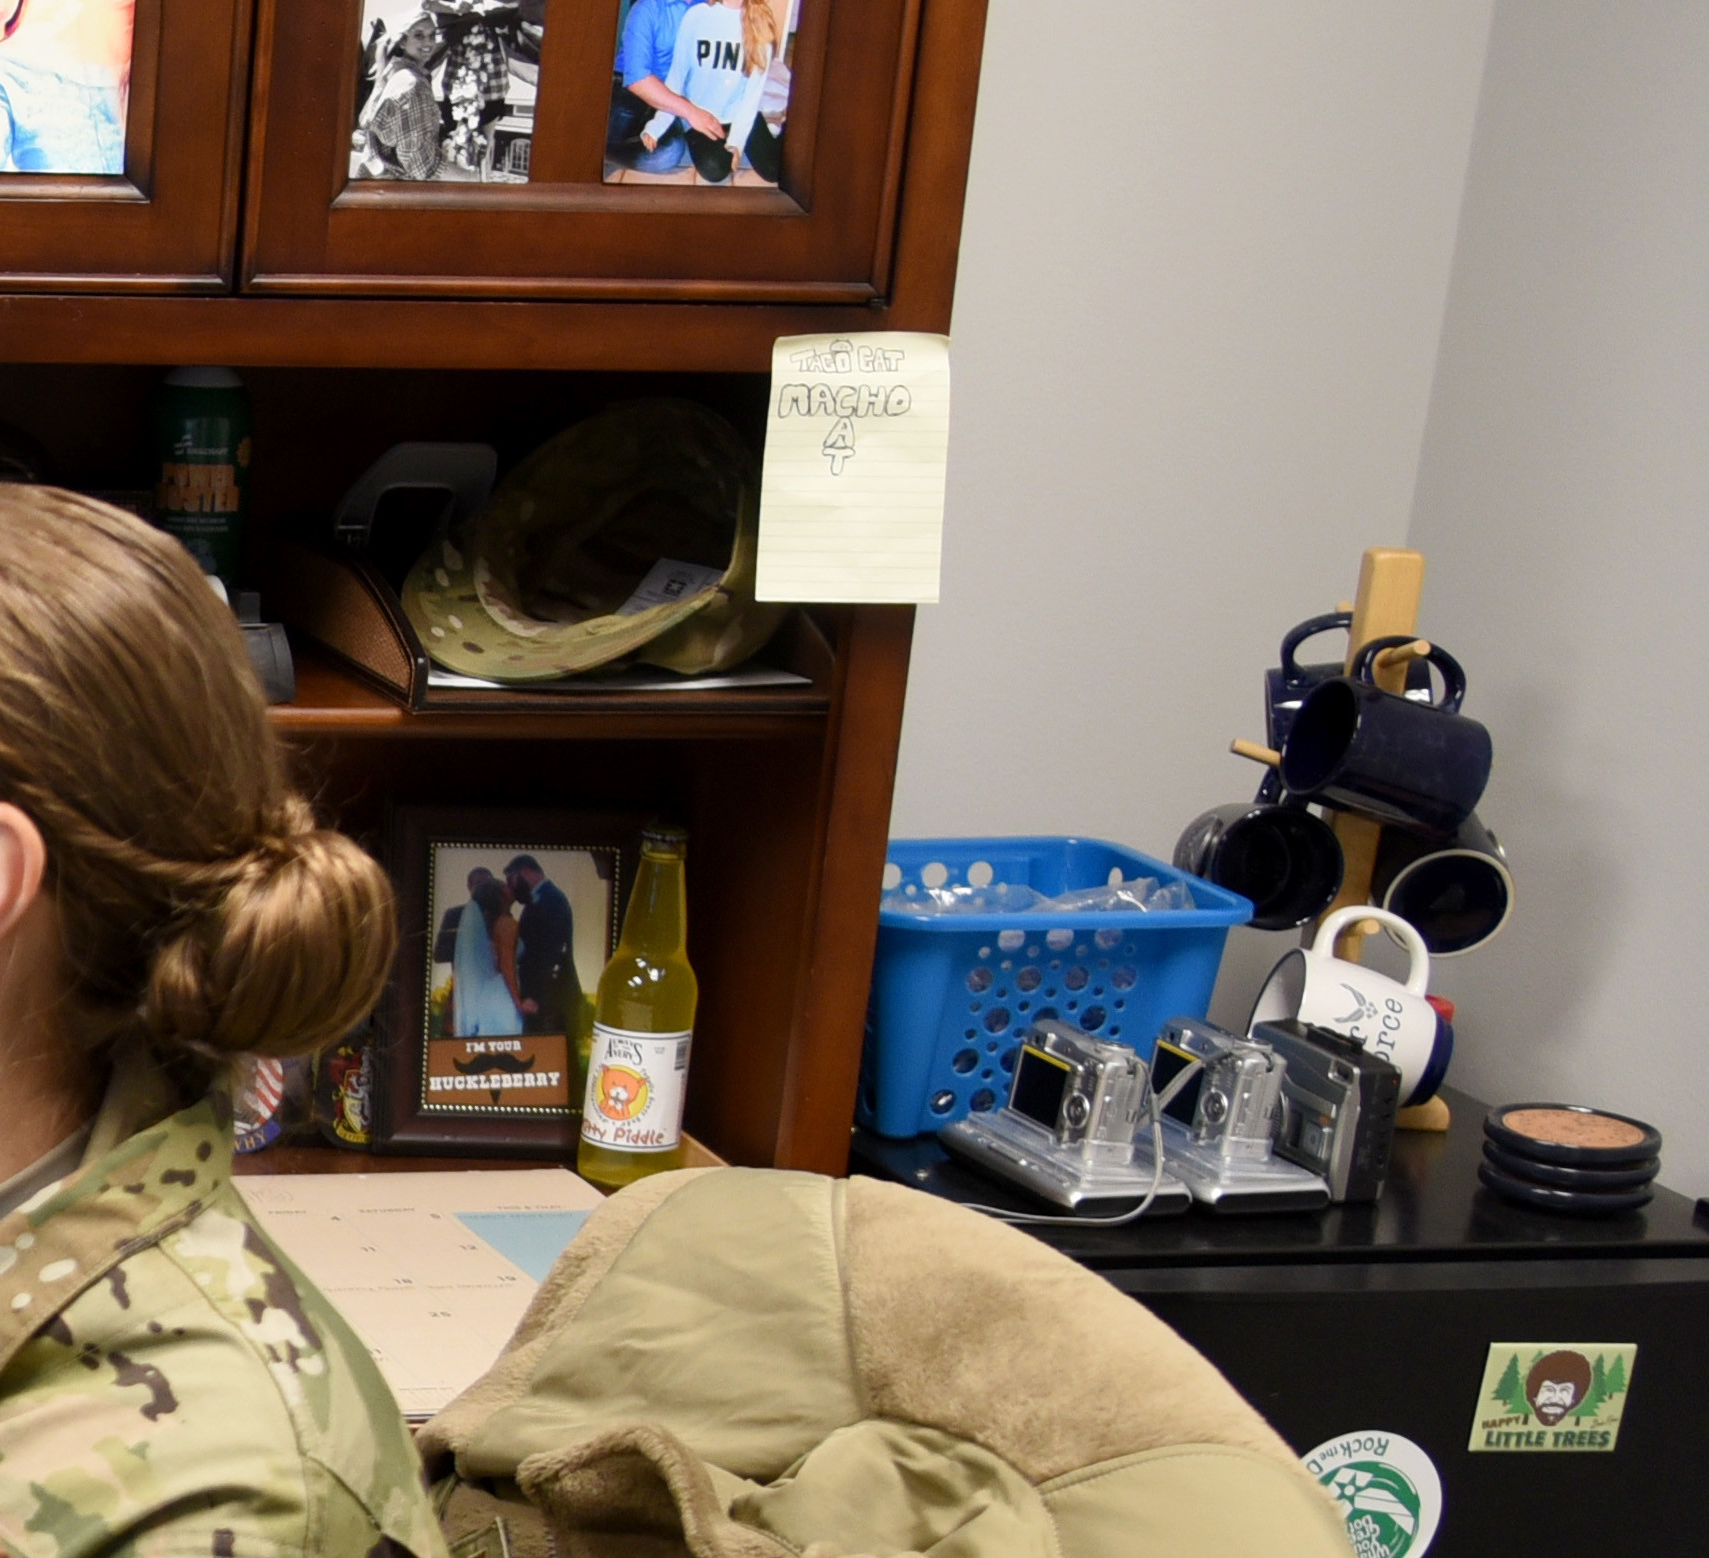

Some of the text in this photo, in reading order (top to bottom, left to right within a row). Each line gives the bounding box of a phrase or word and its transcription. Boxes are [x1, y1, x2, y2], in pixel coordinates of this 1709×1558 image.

[790, 348, 852, 373] TACO
[777, 384, 911, 418] MACHO
[466, 1040, 522, 1053] I'M YOUR
[429, 1072, 560, 1090] HUCKLEBERRY
[612, 1126, 664, 1144] Piddle
[1482, 1415, 1521, 1430] HAPPY
[1484, 1430, 1611, 1449] LITTLE TREES
[1339, 1436, 1390, 1462] Rock
